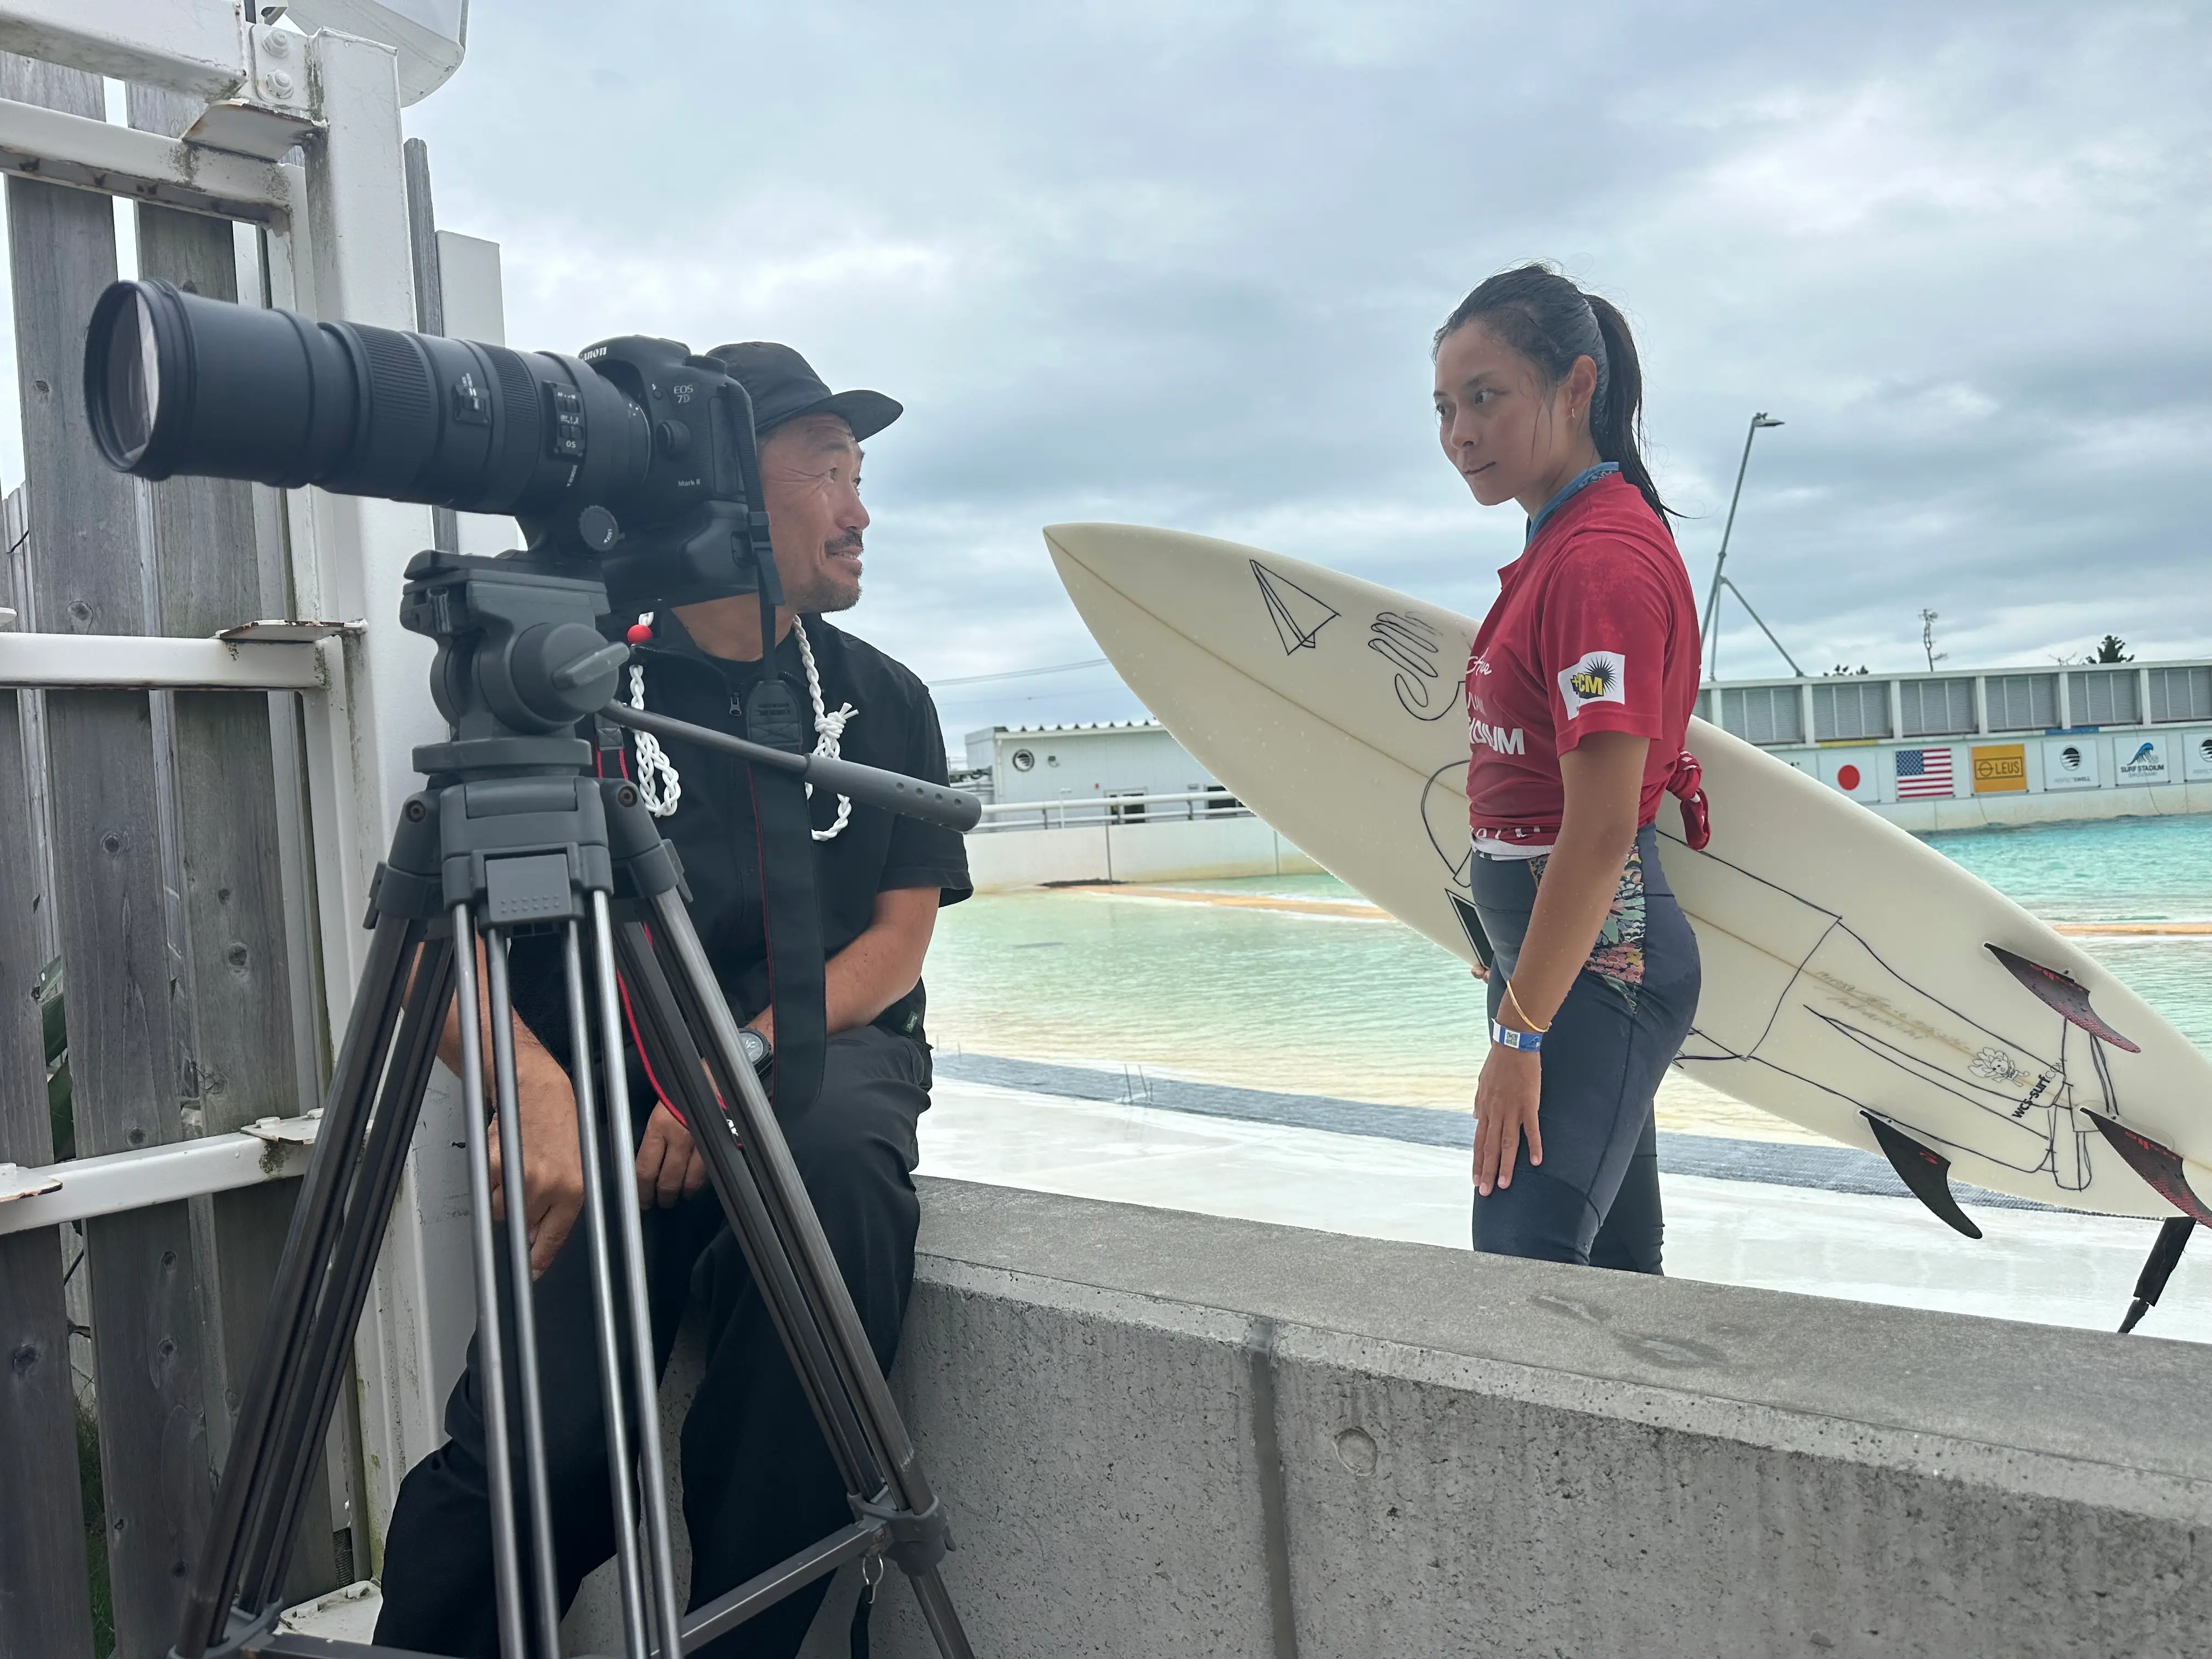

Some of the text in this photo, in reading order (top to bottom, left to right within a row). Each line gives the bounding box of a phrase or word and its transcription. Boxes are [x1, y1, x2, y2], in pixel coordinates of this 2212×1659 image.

[674, 385, 693, 394] EOS
[677, 394, 690, 404] 7D
[1468, 716, 1525, 755] ADIUM
[1995, 760, 2019, 775] LEUS
[2137, 764, 2164, 772] STADIUM
